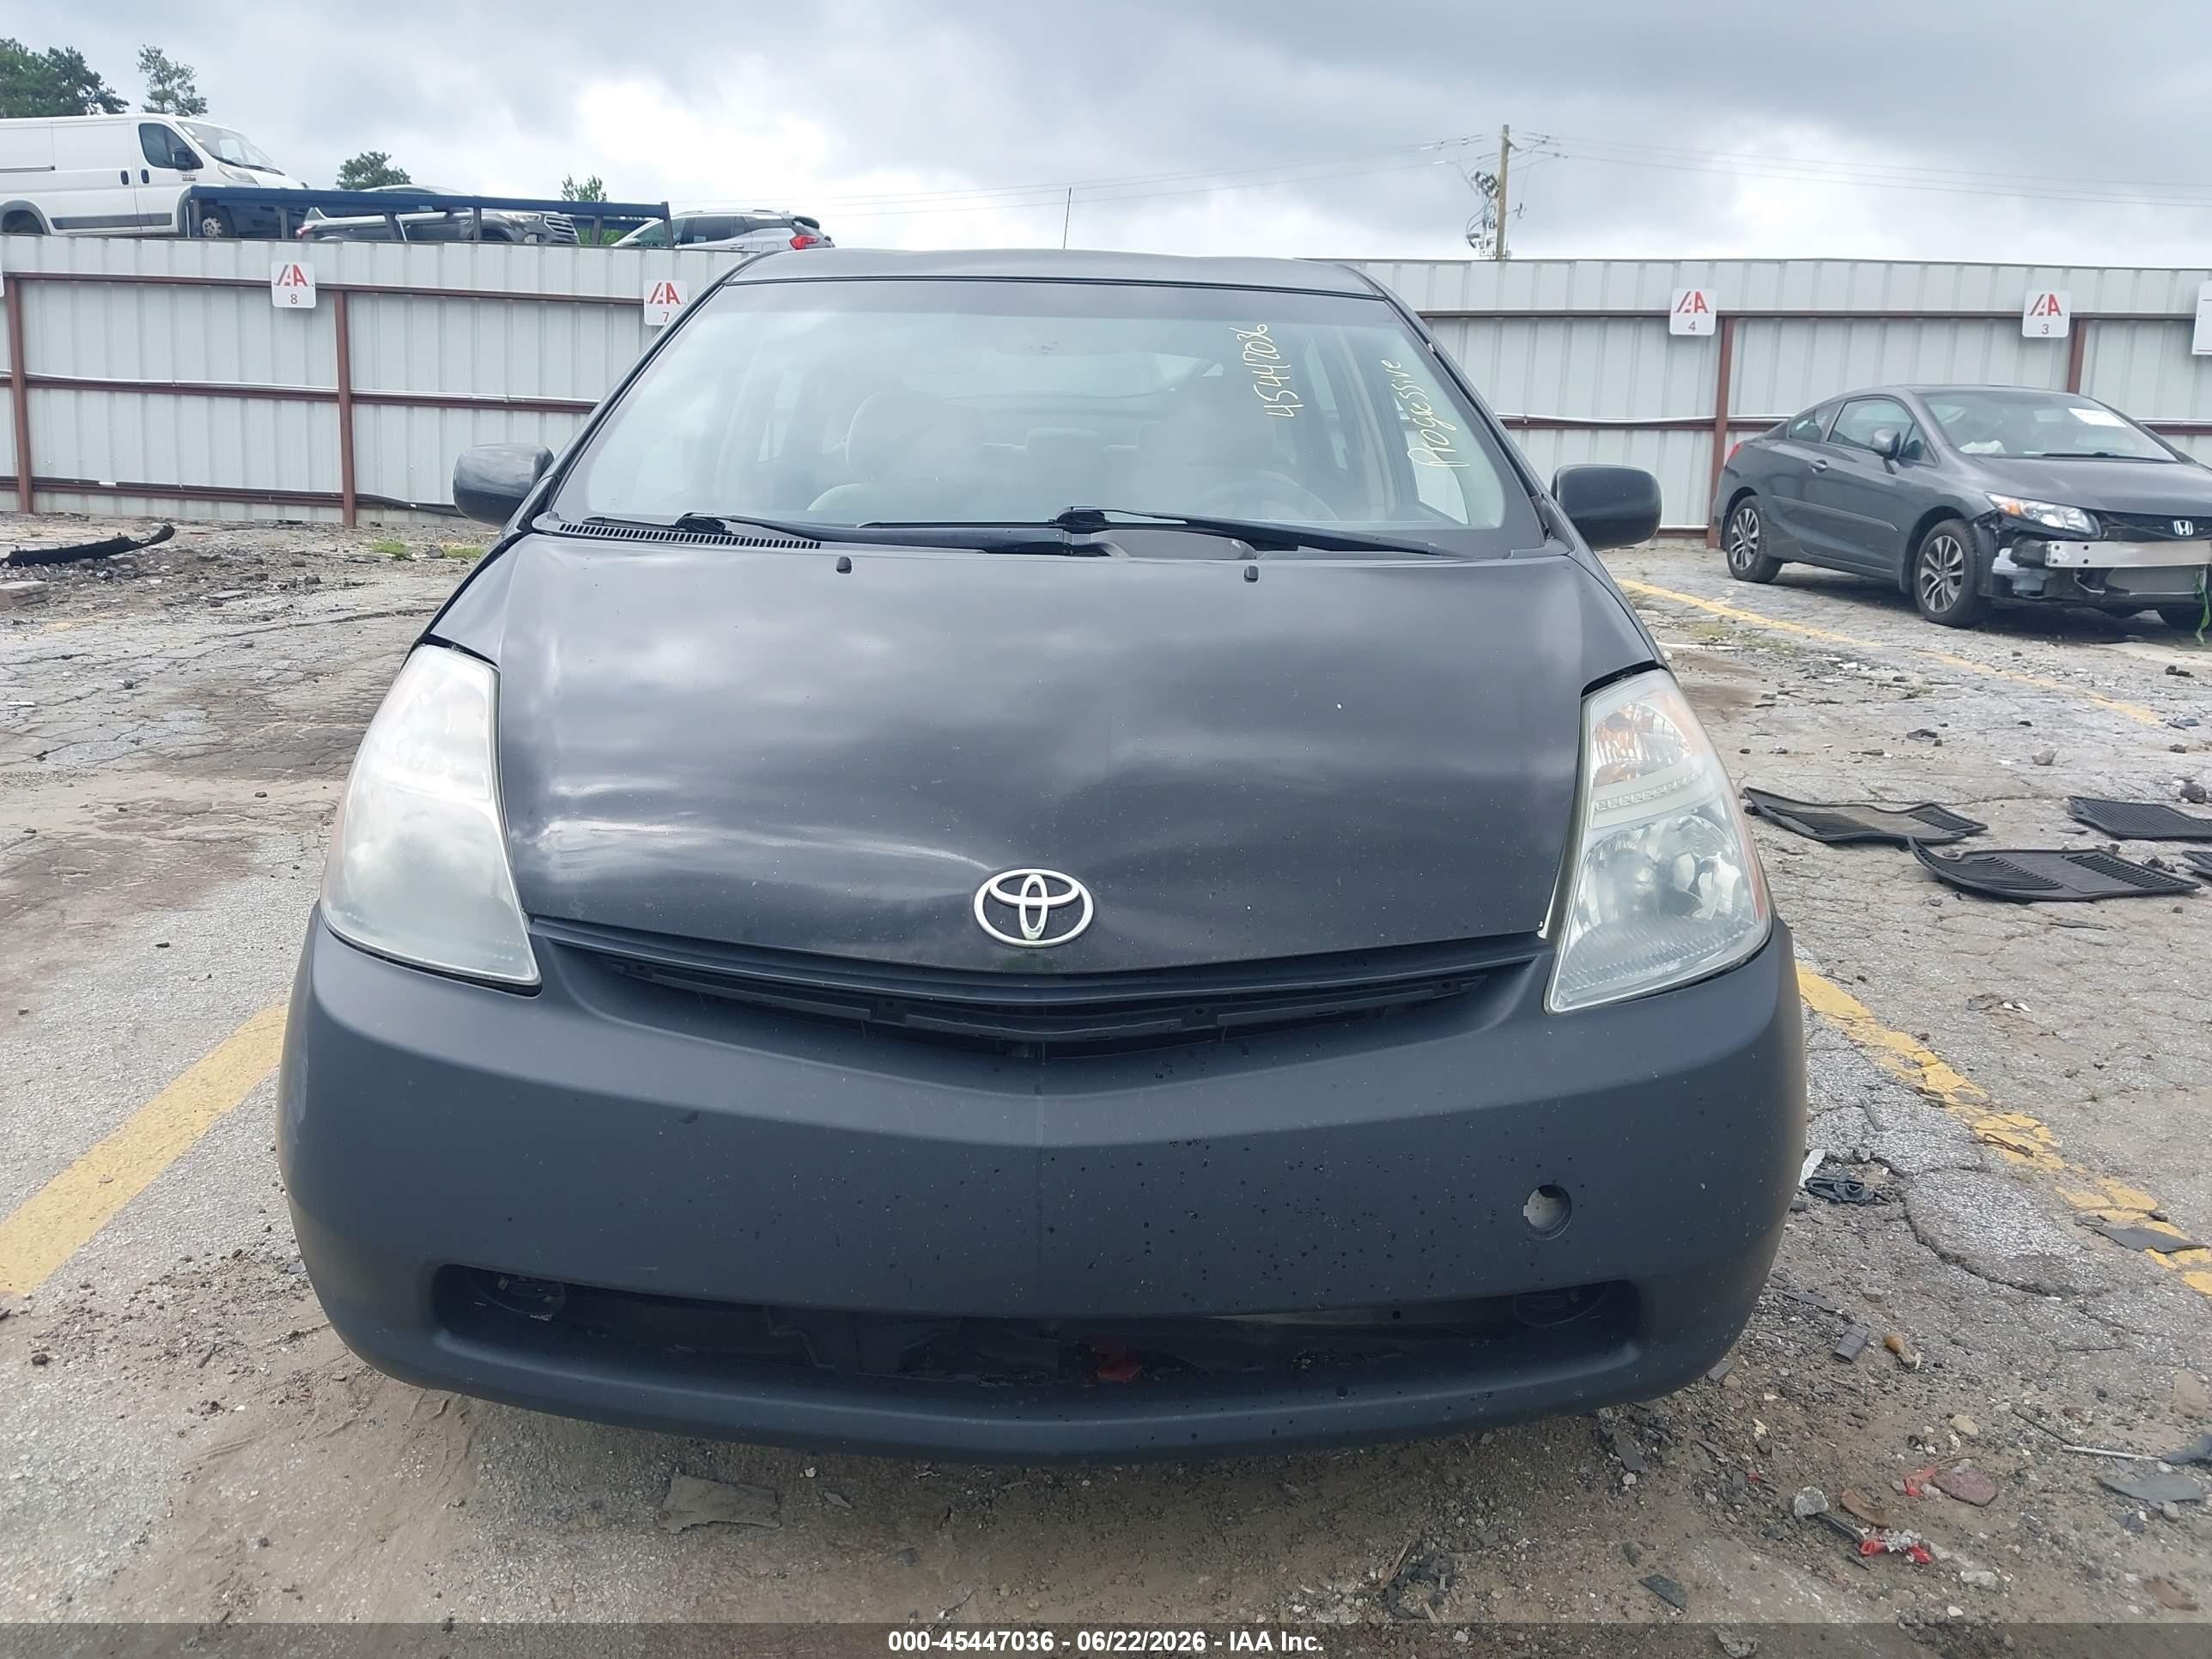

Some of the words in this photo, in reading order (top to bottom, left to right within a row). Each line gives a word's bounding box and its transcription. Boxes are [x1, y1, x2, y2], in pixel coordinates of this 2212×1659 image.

[290, 294, 298, 305] 8
[662, 311, 670, 323] 7
[1687, 320, 1697, 331] 4
[2041, 323, 2050, 335] 3
[1229, 324, 1304, 417] 45447036
